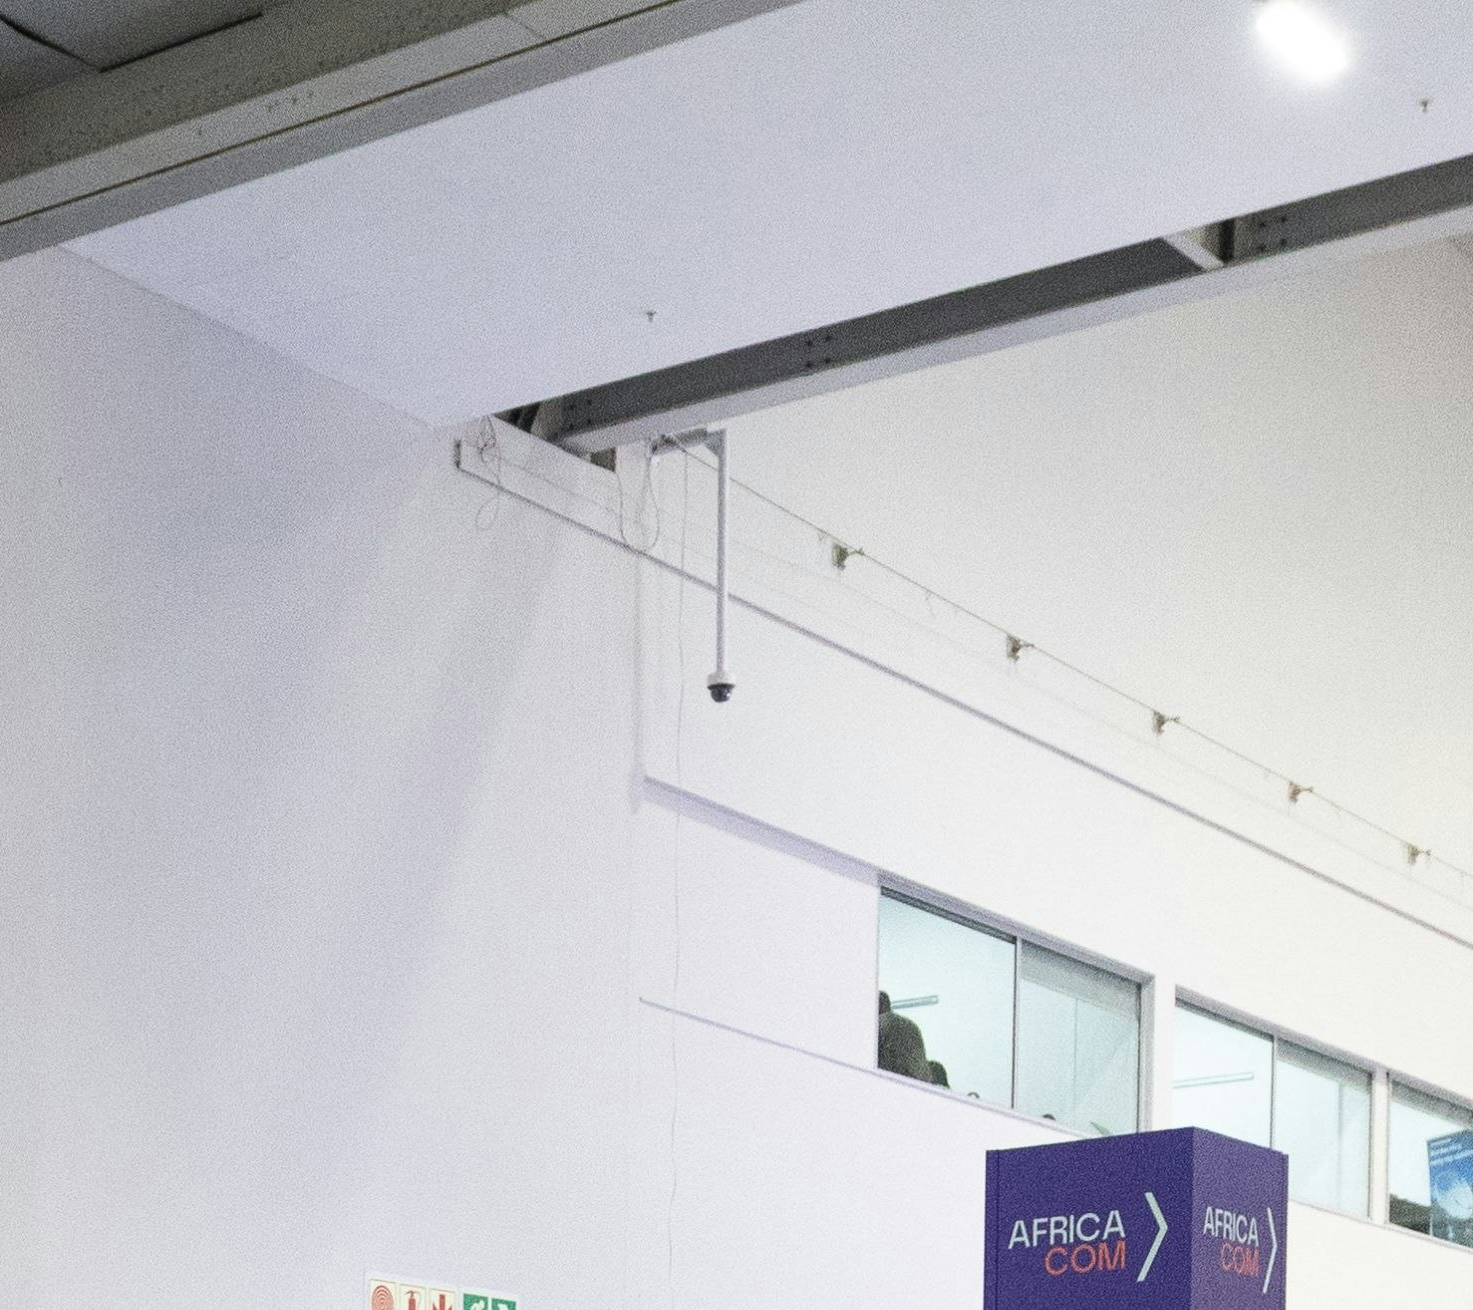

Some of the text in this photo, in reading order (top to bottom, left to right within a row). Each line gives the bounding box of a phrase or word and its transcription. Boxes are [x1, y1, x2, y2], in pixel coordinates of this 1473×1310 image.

[1008, 1210, 1126, 1249] AFRICA
[1204, 1206, 1259, 1247] AFRICA
[1044, 1240, 1126, 1275] COM
[1220, 1242, 1260, 1277] COM
